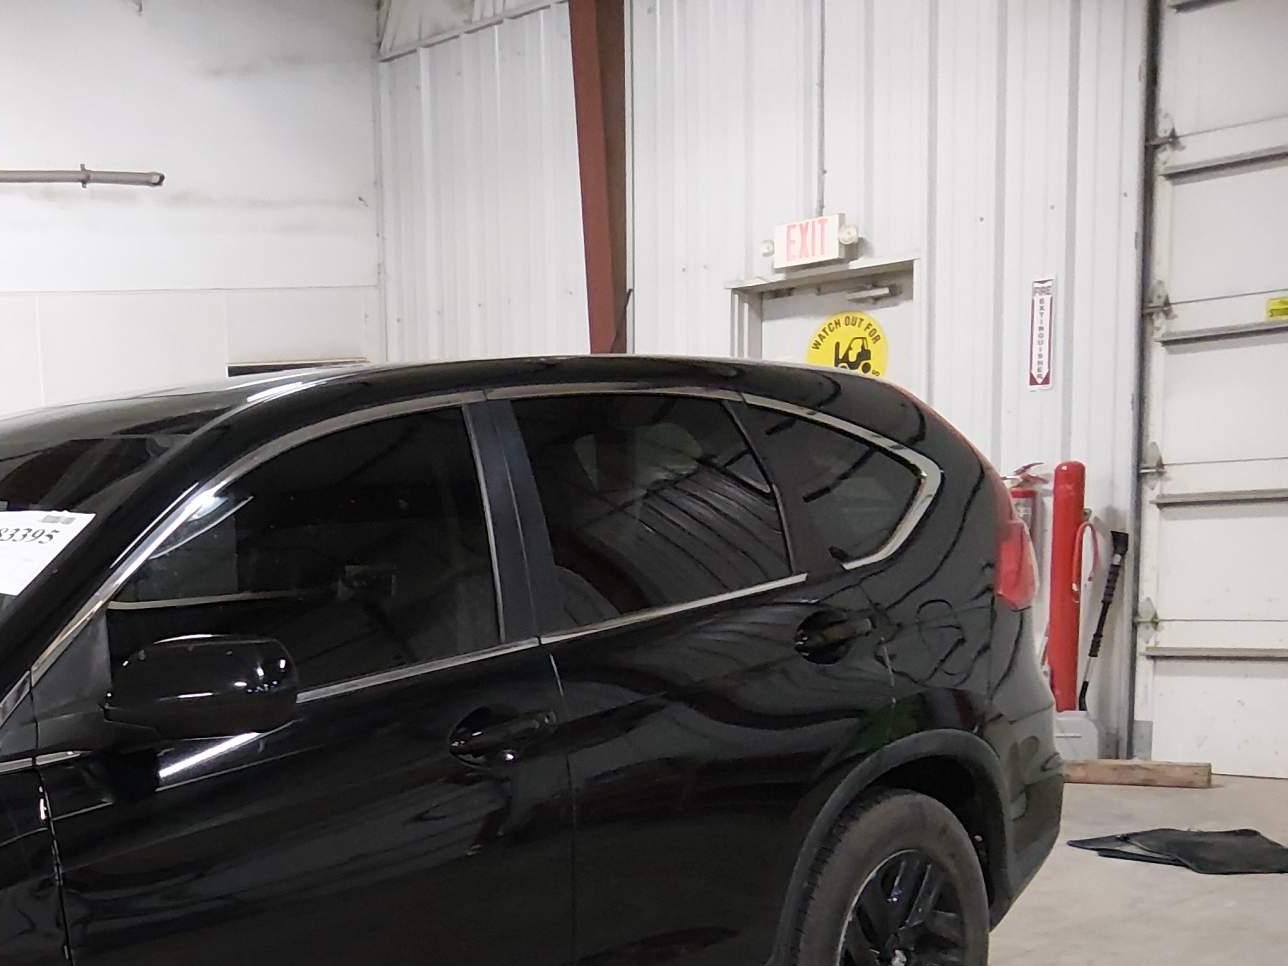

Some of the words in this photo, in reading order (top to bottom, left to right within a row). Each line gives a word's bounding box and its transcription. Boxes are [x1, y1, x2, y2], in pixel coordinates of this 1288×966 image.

[786, 218, 829, 261] EXIT
[1033, 286, 1052, 296] FIRE
[811, 318, 842, 351] WATCH
[844, 315, 865, 329] OUT
[863, 323, 882, 344] FOR
[1036, 298, 1046, 379] EXTINGUISHER
